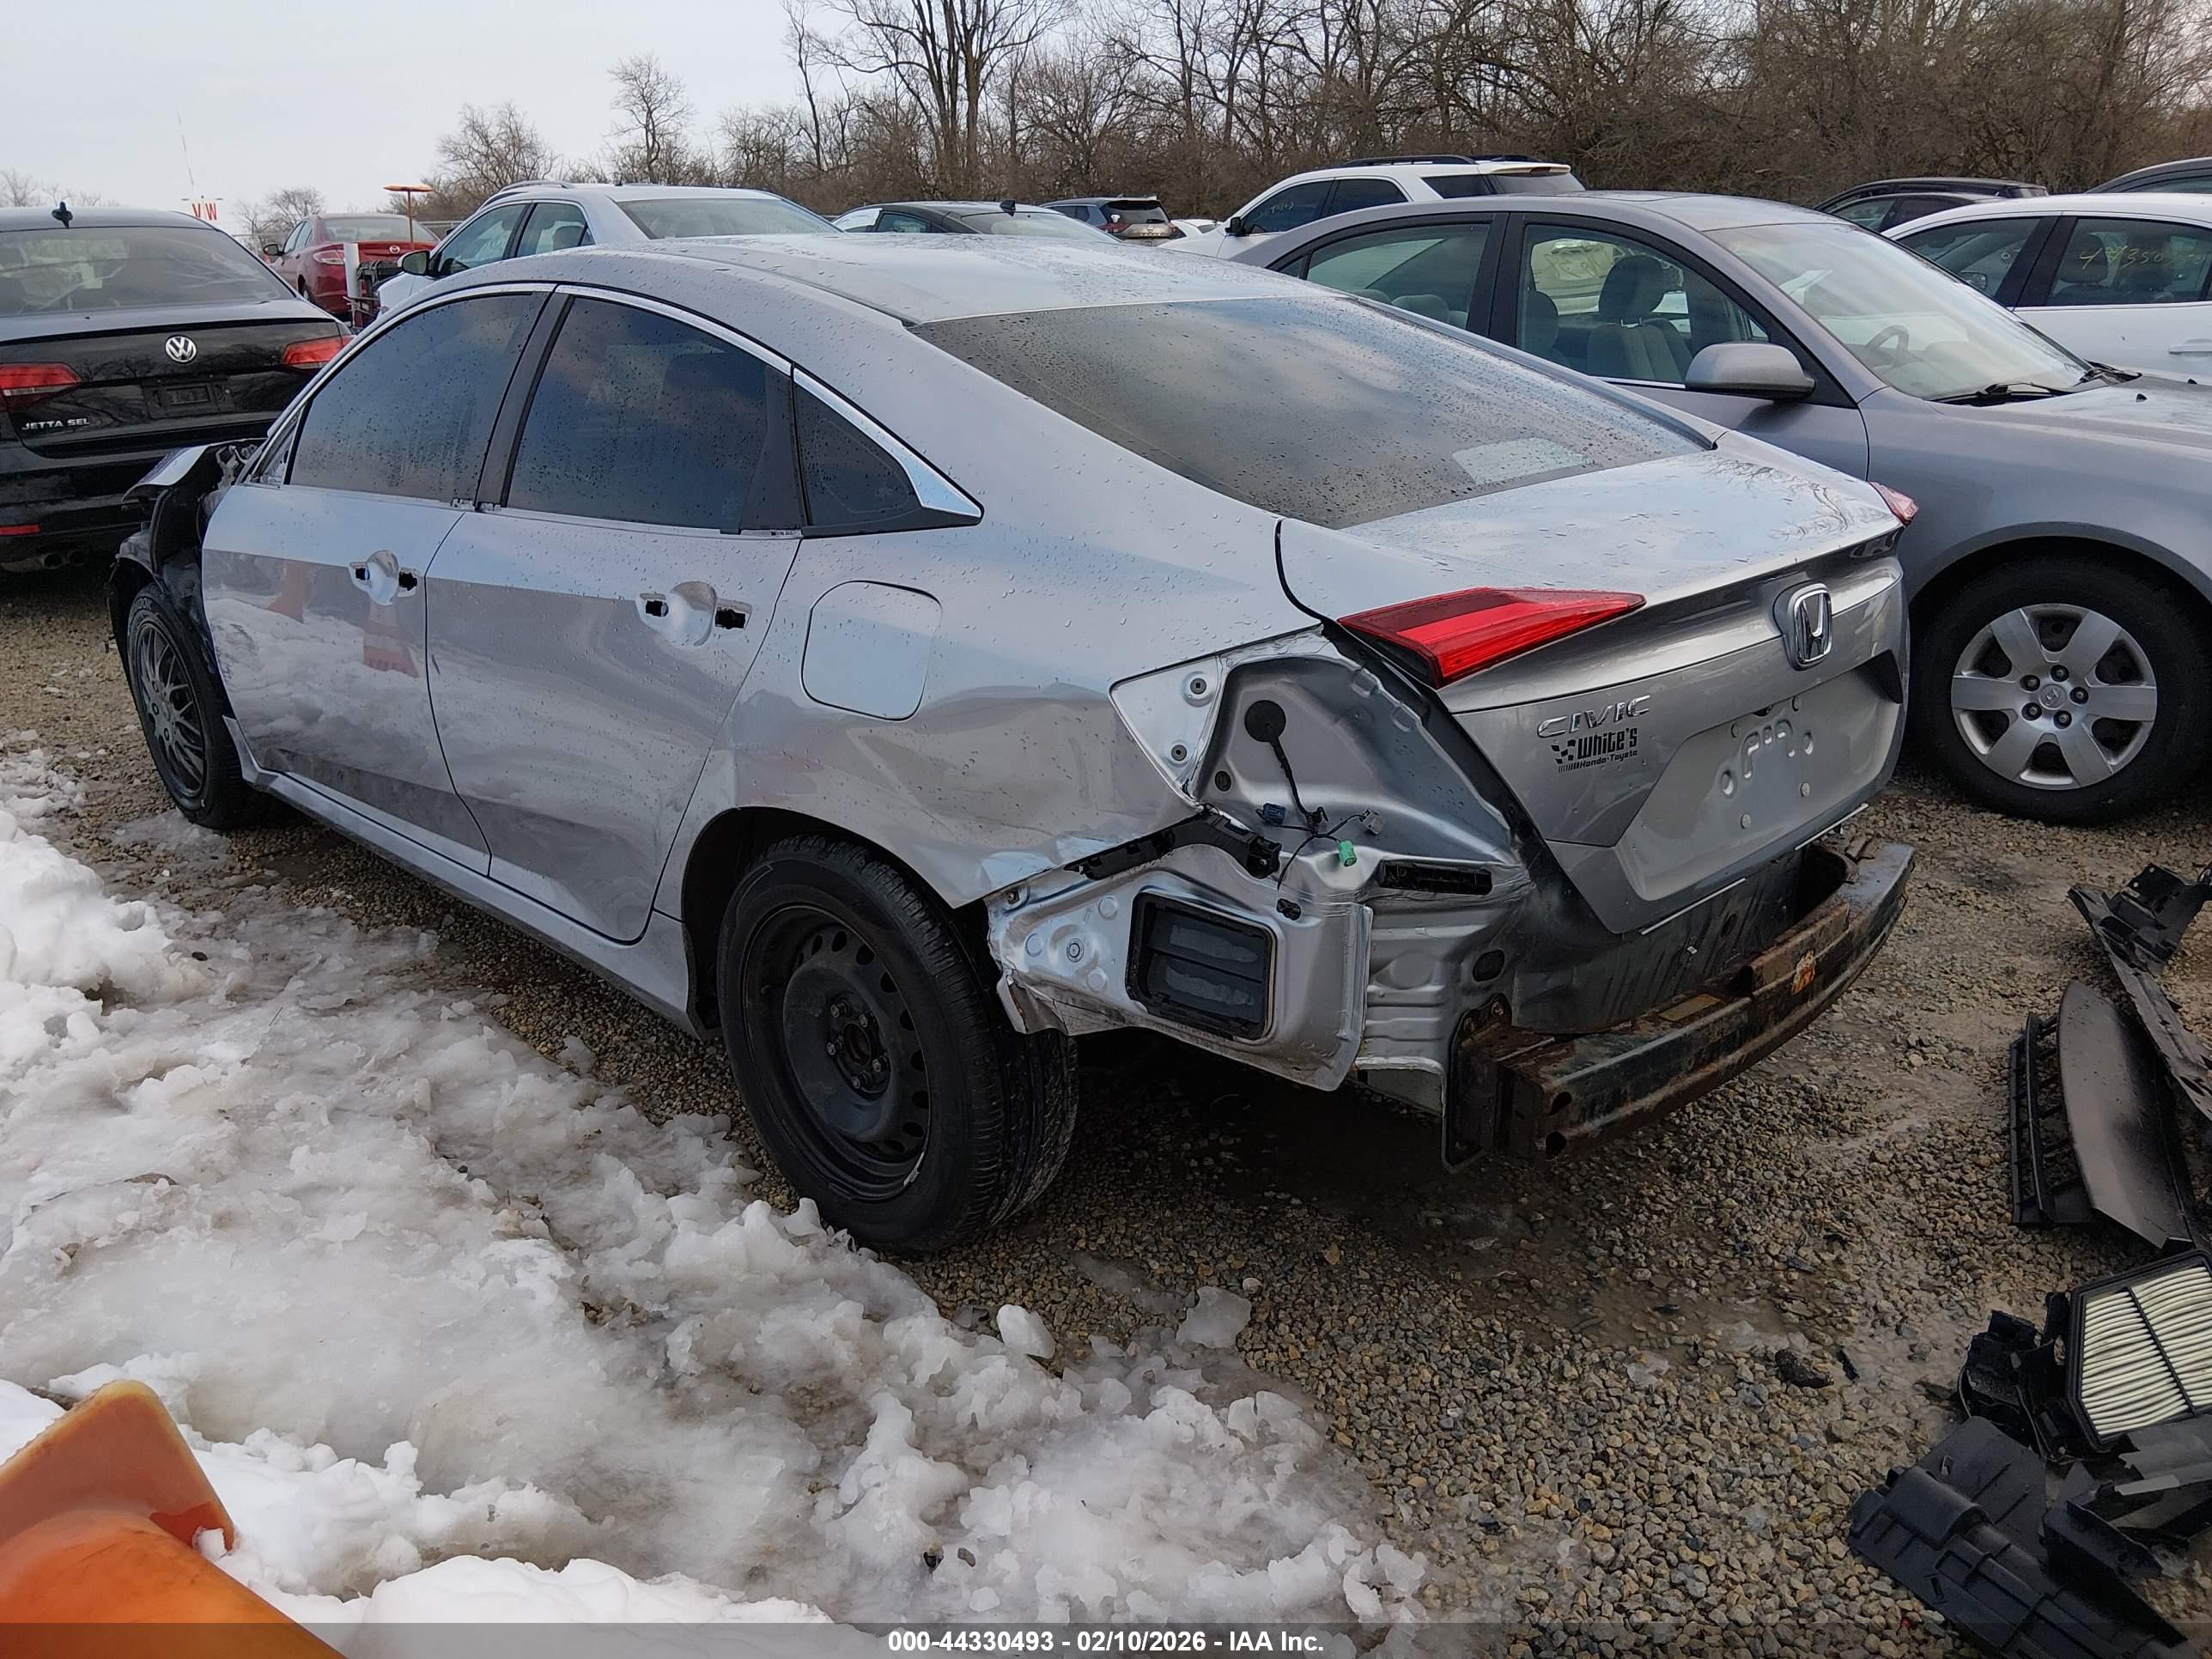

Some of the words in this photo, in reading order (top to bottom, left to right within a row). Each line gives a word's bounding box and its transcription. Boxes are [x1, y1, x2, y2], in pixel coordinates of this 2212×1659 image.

[21, 420, 64, 430] JETTA
[67, 418, 90, 427] SEL
[1537, 695, 1650, 738] CIVIC
[1577, 727, 1638, 760] White's
